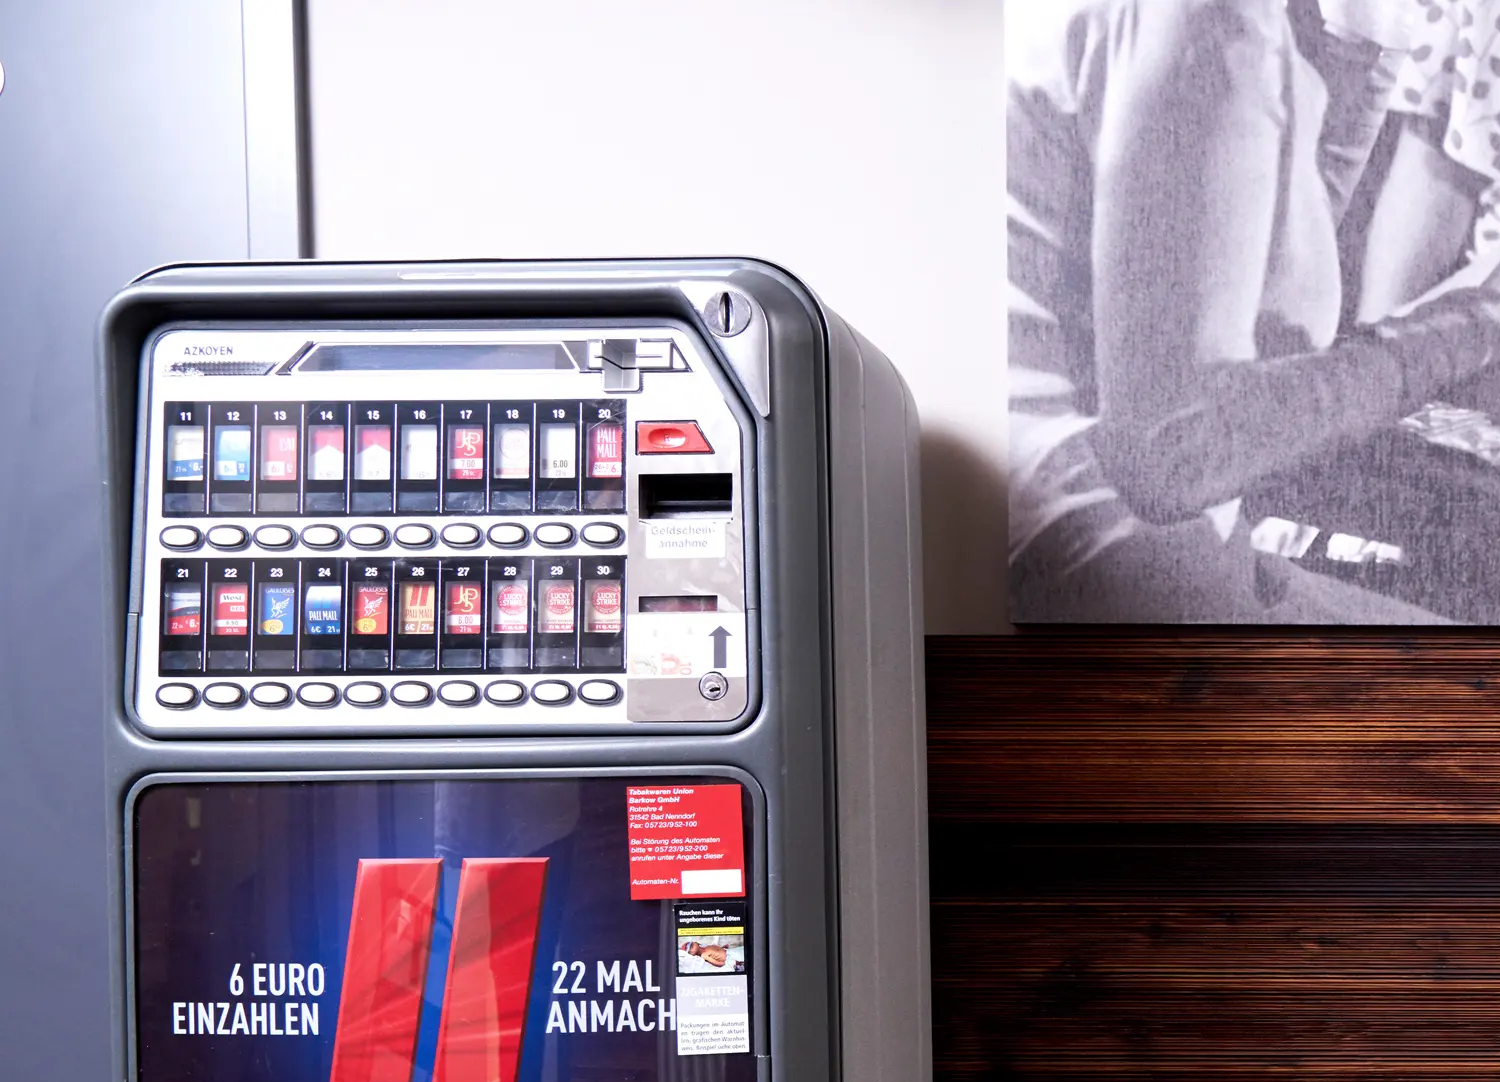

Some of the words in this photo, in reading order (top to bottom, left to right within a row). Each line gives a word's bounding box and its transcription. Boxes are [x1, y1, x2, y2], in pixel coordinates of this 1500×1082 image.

[184, 346, 233, 356] AZKOYEN
[180, 411, 192, 421] 11
[226, 411, 240, 421] 12
[273, 411, 287, 420] 13
[320, 410, 333, 420] 14
[367, 410, 380, 420] 15
[413, 410, 427, 420] 16
[460, 410, 473, 419] 17
[506, 409, 519, 419] 18
[553, 409, 566, 419] 19
[598, 409, 611, 419] 20
[597, 428, 617, 443] PALL
[597, 444, 618, 458] MALL
[553, 460, 569, 468] 6.00
[651, 526, 716, 536] Geldschein-
[658, 539, 708, 549] annahme
[177, 568, 189, 578] 21
[224, 568, 238, 578] 22
[270, 568, 284, 578] 23
[318, 567, 331, 577] 24
[365, 567, 378, 577] 25
[412, 567, 425, 577] 26
[457, 567, 470, 577] 27
[504, 566, 517, 576] 28
[551, 566, 564, 576] 29
[597, 565, 610, 575] 30
[309, 611, 322, 621] PALL
[323, 611, 338, 621] MALL
[458, 616, 473, 625] 6.00
[643, 838, 669, 846] Störung
[679, 916, 713, 924] ungeborenes
[229, 963, 244, 996] 6
[253, 962, 325, 996] EURO
[552, 961, 586, 994] 22
[597, 960, 661, 993] MAL
[173, 1002, 319, 1035] EINZAHLEN
